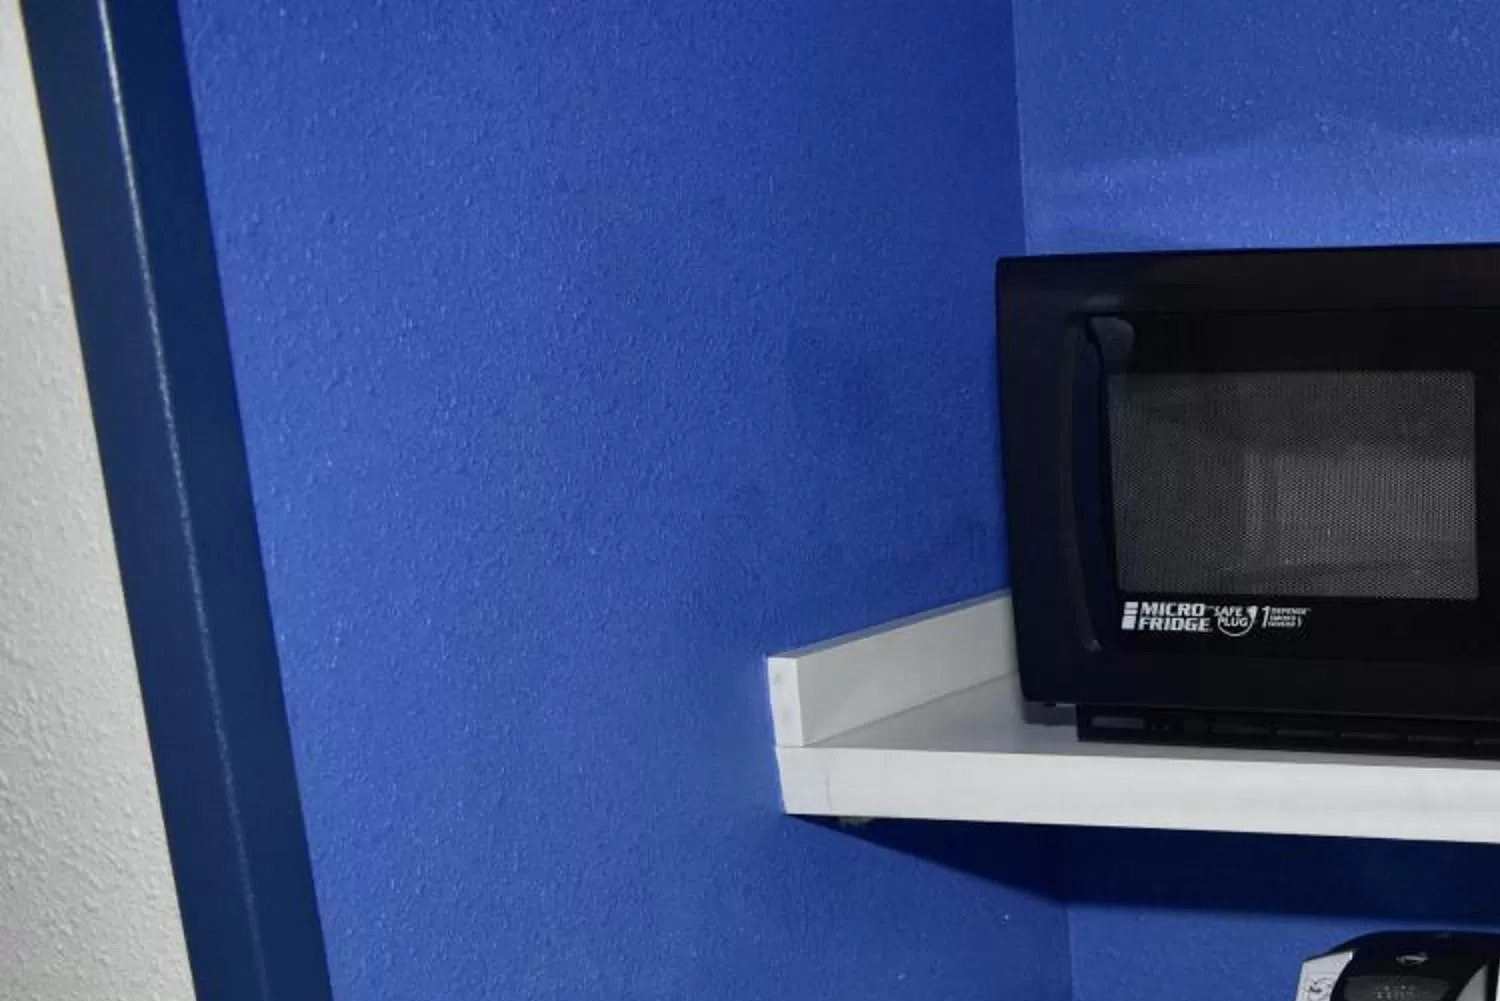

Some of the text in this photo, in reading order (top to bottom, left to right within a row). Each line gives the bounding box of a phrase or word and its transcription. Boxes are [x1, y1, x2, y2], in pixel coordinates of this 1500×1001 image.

[1140, 601, 1206, 617] MICRO
[1214, 605, 1243, 617] SAFE
[1138, 616, 1211, 631] FRIDGE
[1217, 615, 1248, 627] PLUG
